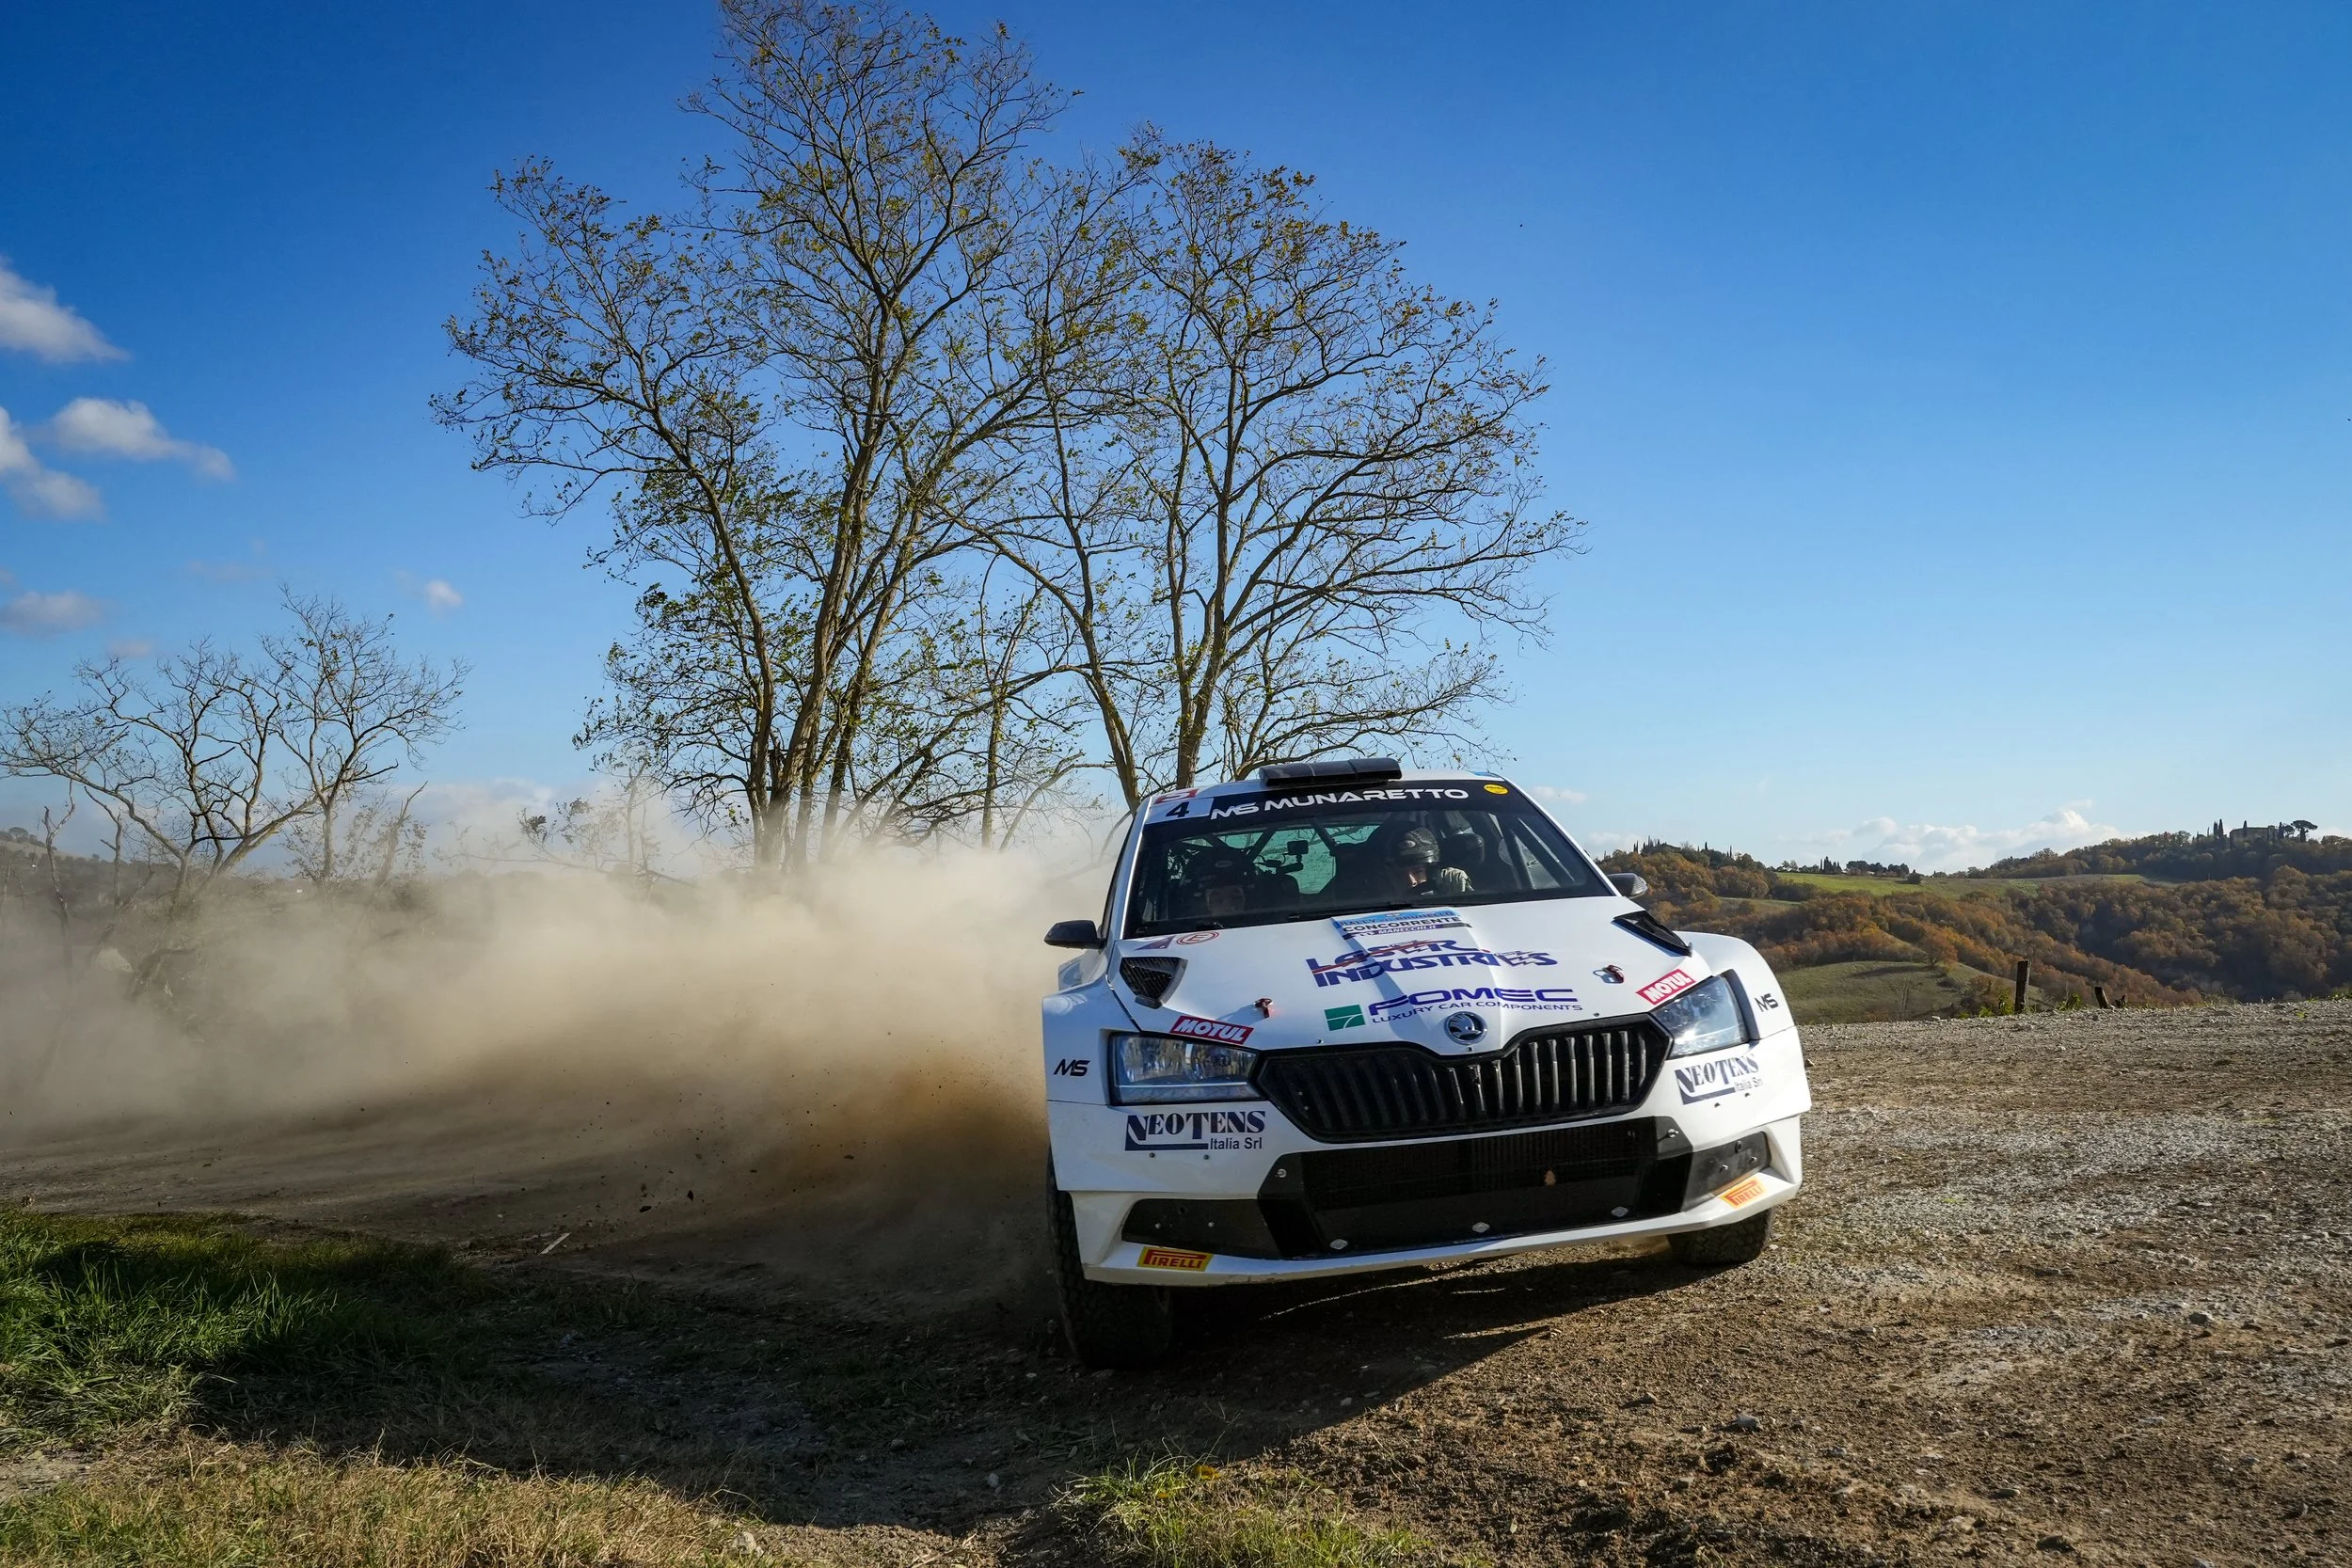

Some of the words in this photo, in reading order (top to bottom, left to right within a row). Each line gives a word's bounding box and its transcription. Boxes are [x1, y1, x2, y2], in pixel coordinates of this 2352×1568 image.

[1165, 801, 1190, 817] 4
[1211, 802, 1260, 820] MS
[1263, 788, 1470, 811] MUNARETTO
[1343, 916, 1462, 931] CONCORRENTE
[1313, 950, 1558, 988] INDUSTRIES
[1642, 972, 1693, 1003] MOTUL
[1368, 988, 1579, 1017] FOMEC
[1372, 1006, 1435, 1023] LUXURY
[1438, 1001, 1471, 1010] CAR
[1475, 1001, 1582, 1011] COMPONENTS
[1754, 993, 1779, 1013] MS
[1175, 1018, 1248, 1041] MOTUL
[1053, 1059, 1090, 1077] MS
[1675, 1053, 1759, 1095] NEOTENS
[1126, 1111, 1266, 1143] NEOTENS
[1210, 1137, 1240, 1150] Italia
[1244, 1137, 1263, 1149] Srl
[1724, 1180, 1763, 1206] PIRELLI
[1143, 1249, 1208, 1269] PIRELLI
